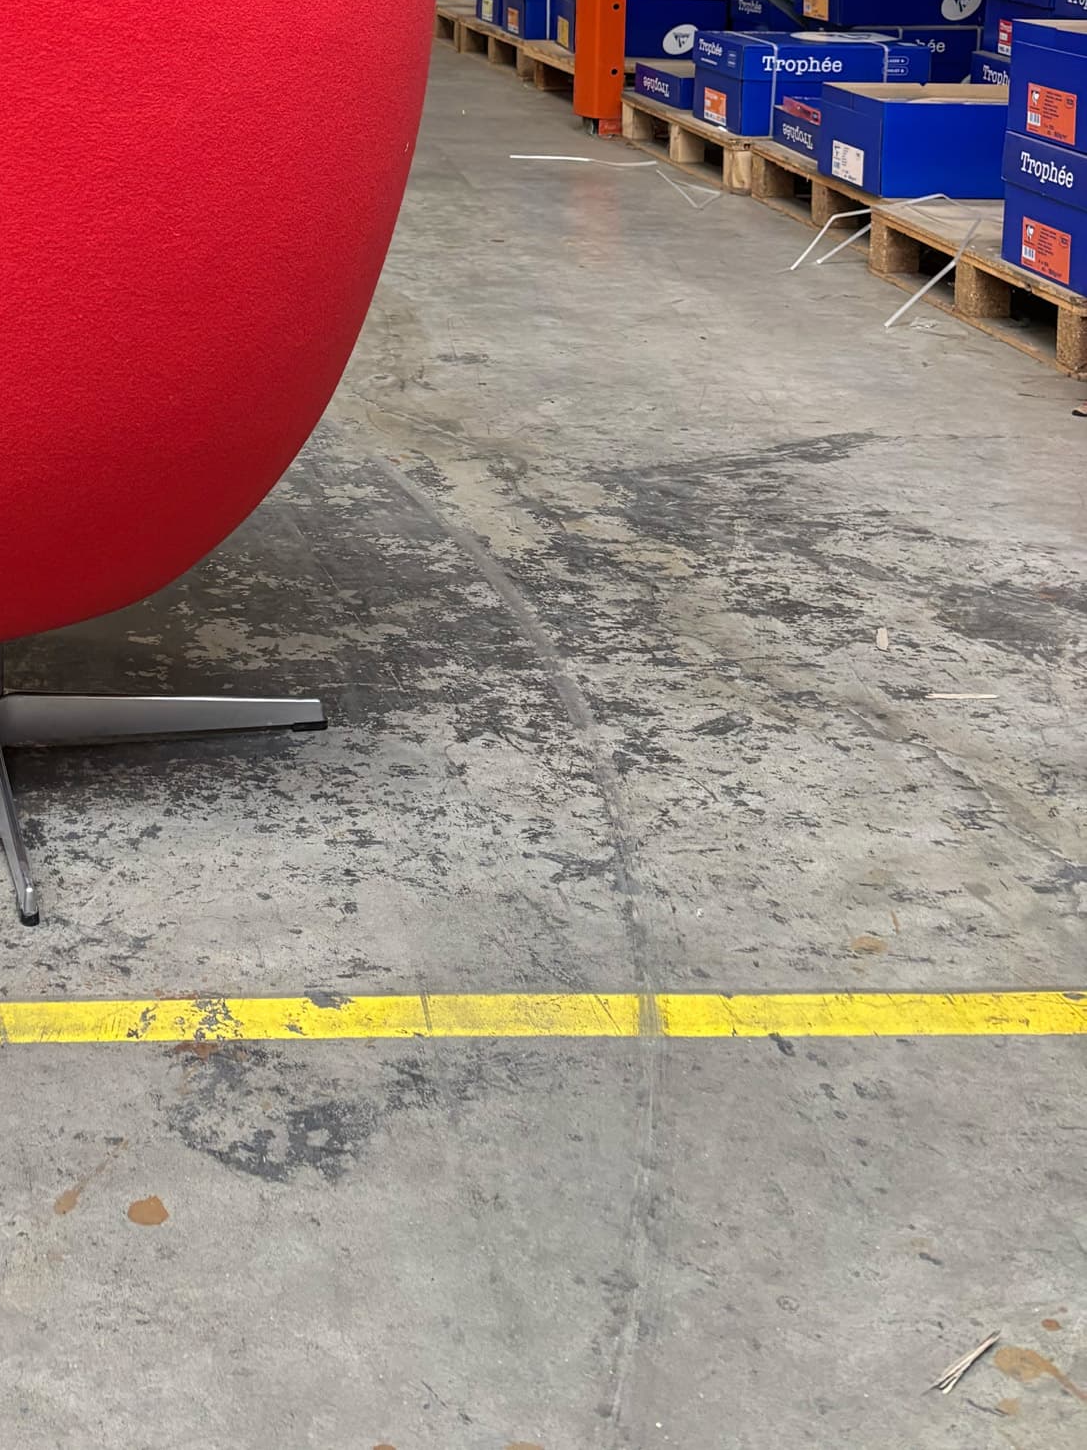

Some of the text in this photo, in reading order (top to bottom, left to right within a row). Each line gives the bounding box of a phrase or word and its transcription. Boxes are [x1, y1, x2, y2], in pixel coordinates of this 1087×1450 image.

[762, 55, 843, 75] Trophée
[982, 64, 1010, 86] Troph
[781, 122, 814, 150] Trophée
[1020, 150, 1074, 189] Trophée
